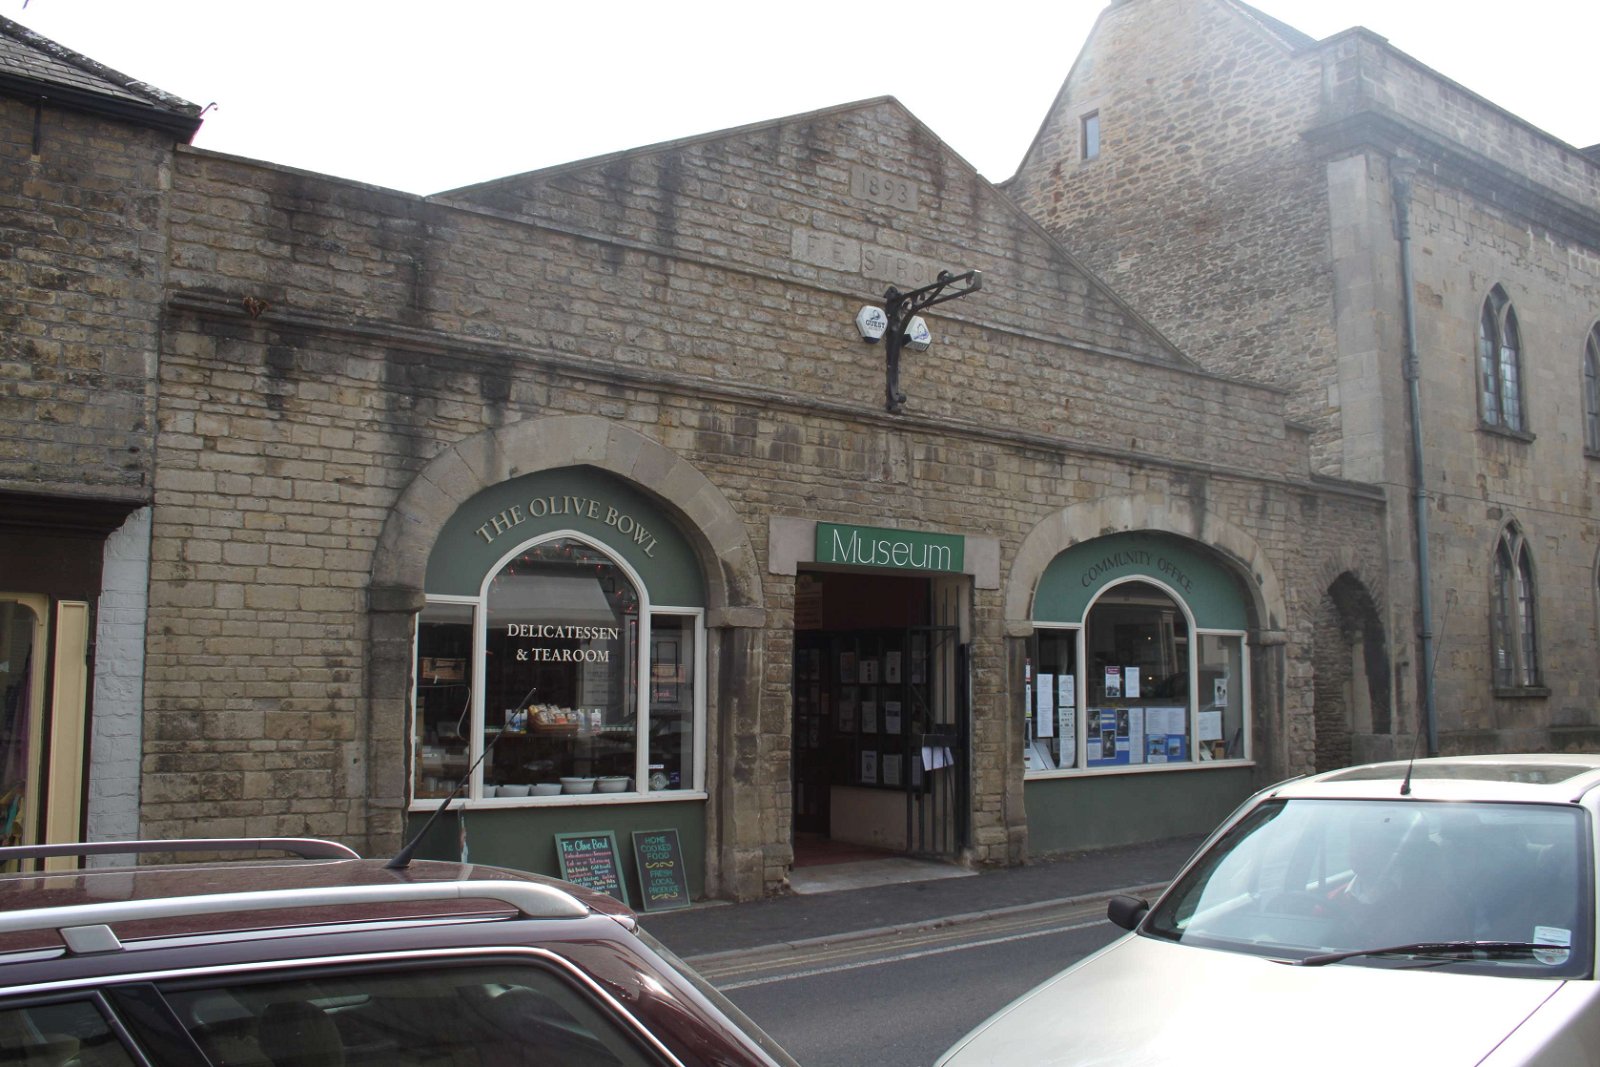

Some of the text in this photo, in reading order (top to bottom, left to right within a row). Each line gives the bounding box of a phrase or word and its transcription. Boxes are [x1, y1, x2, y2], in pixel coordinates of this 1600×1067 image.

[862, 172, 907, 204] 1893
[475, 495, 658, 558] THE OLIVE BOWL
[832, 528, 951, 570] Museum
[1081, 551, 1193, 594] COMMUNITY OFFICE
[507, 623, 619, 641] DELICATESSEN
[516, 648, 610, 662] & TEAROOM
[640, 844, 672, 853] COOKED
[645, 836, 666, 845] HOME
[647, 852, 670, 860] FOOD
